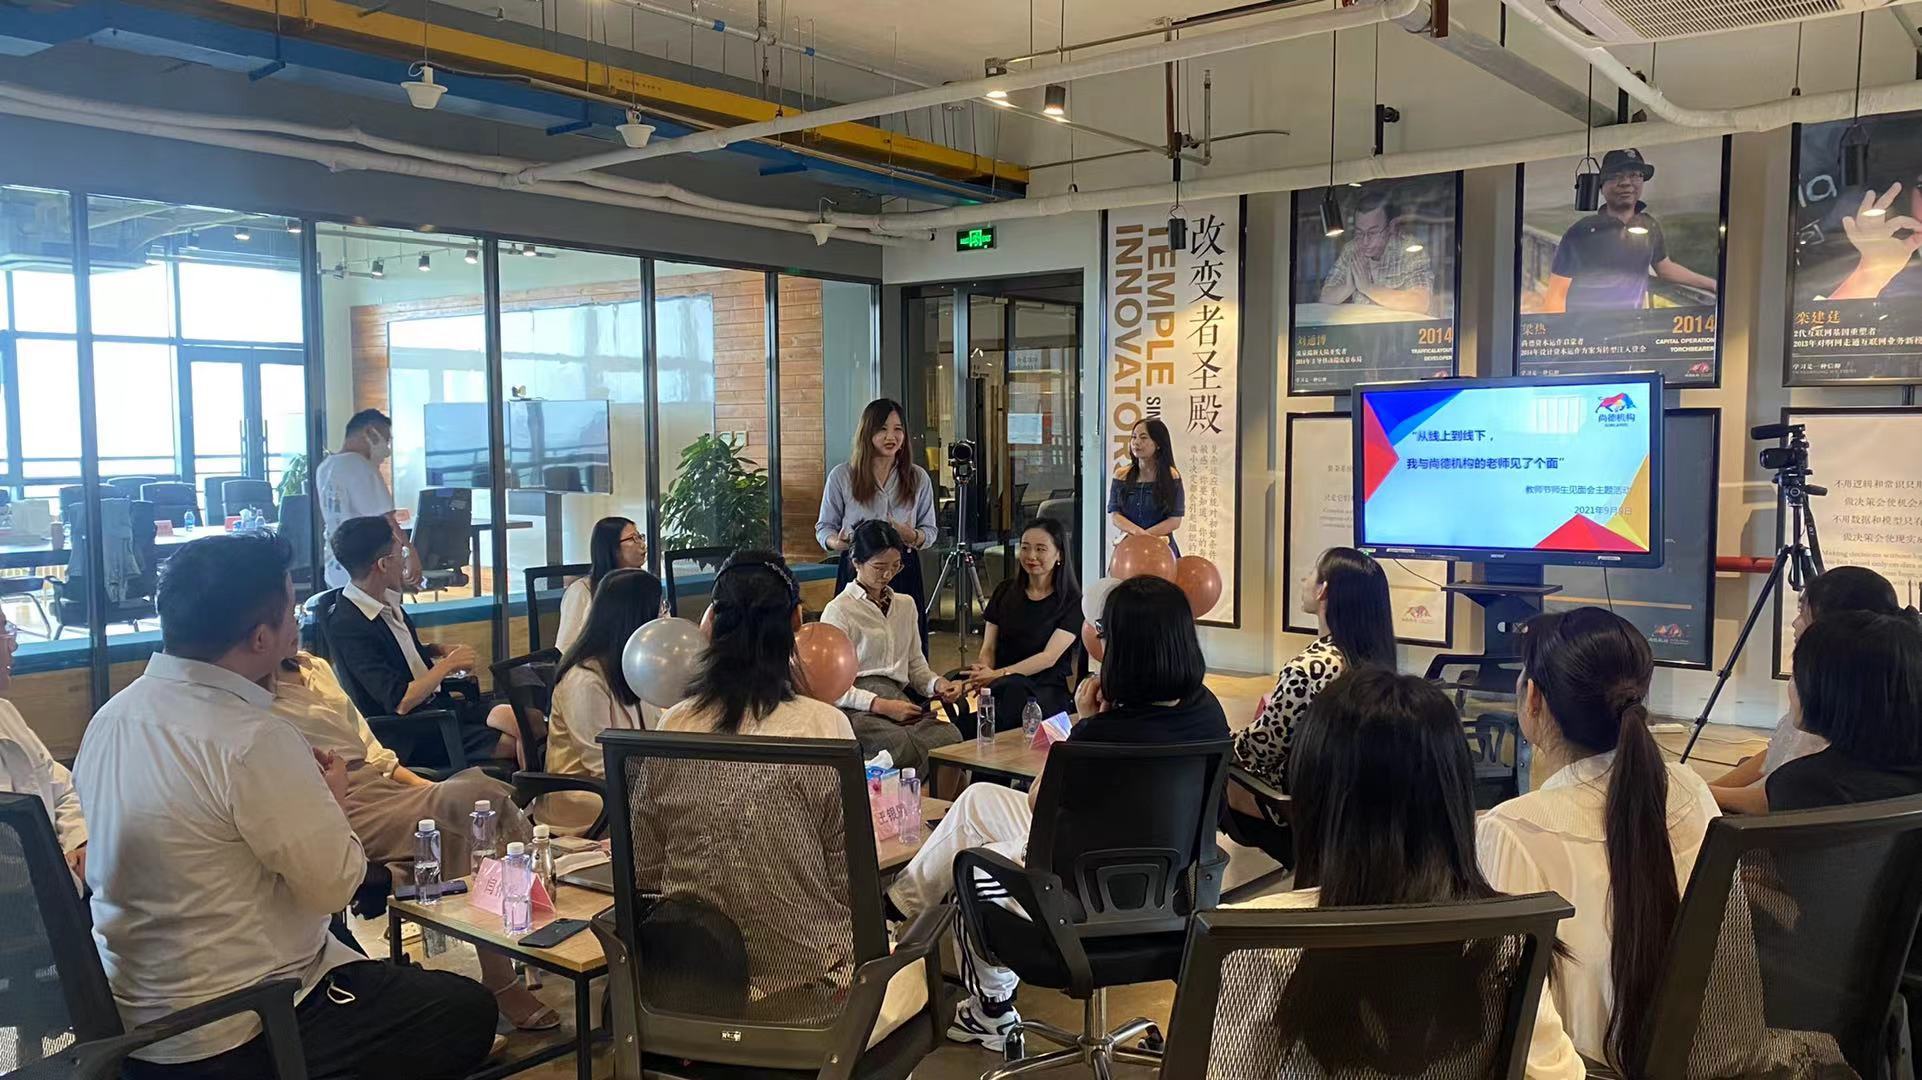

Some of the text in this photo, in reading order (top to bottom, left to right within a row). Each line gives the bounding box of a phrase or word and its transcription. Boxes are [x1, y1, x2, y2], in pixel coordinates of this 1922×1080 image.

[1186, 214, 1225, 435] 改变者圣殿
[1672, 315, 1715, 334] 2014
[1418, 327, 1454, 344] 2014
[1112, 224, 1143, 474] INNOVATOR
[1598, 413, 1636, 423] 尚德机构
